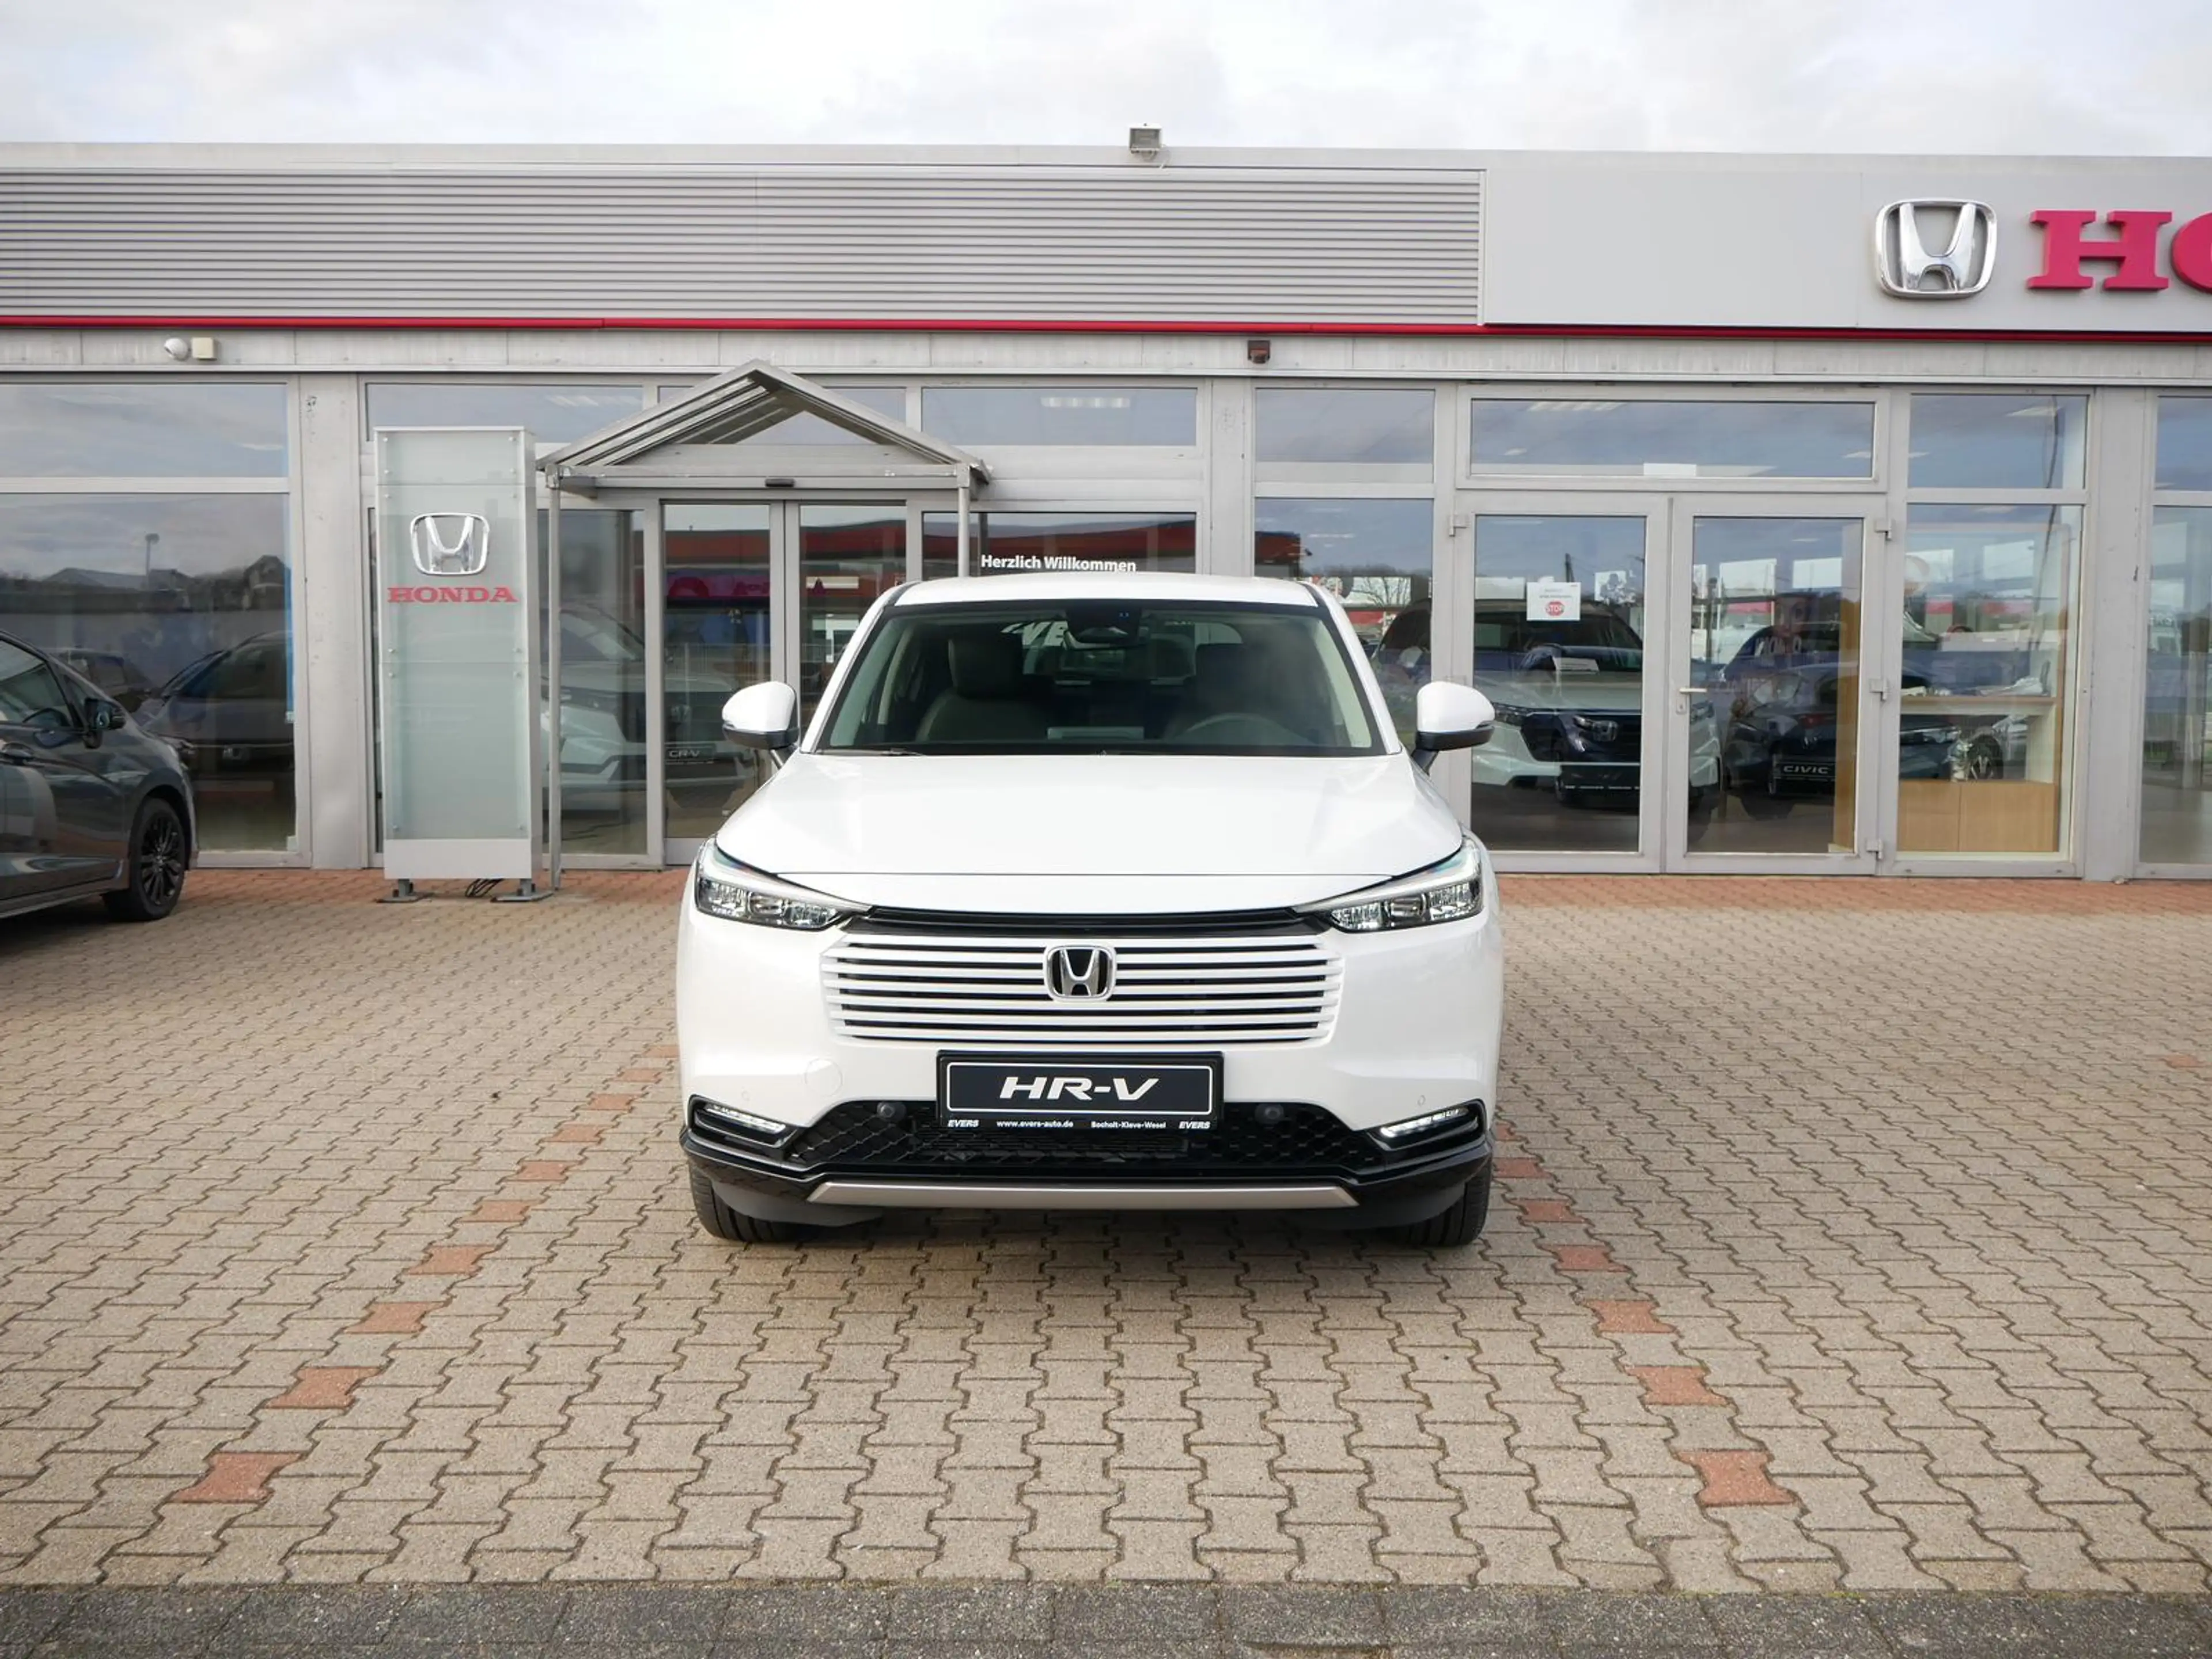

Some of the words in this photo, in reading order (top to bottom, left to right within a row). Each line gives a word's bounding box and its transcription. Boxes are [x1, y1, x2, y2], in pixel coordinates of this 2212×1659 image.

[981, 554, 1041, 569] Herzlich
[1044, 556, 1136, 573] Willkommen
[387, 586, 518, 603] HONDA
[1783, 765, 1829, 774] CIVIC
[999, 1076, 1159, 1101] HR-V
[948, 1120, 979, 1128] EVERS
[997, 1120, 1074, 1128] www.evers-auto.de
[1179, 1121, 1211, 1129] EVERS
